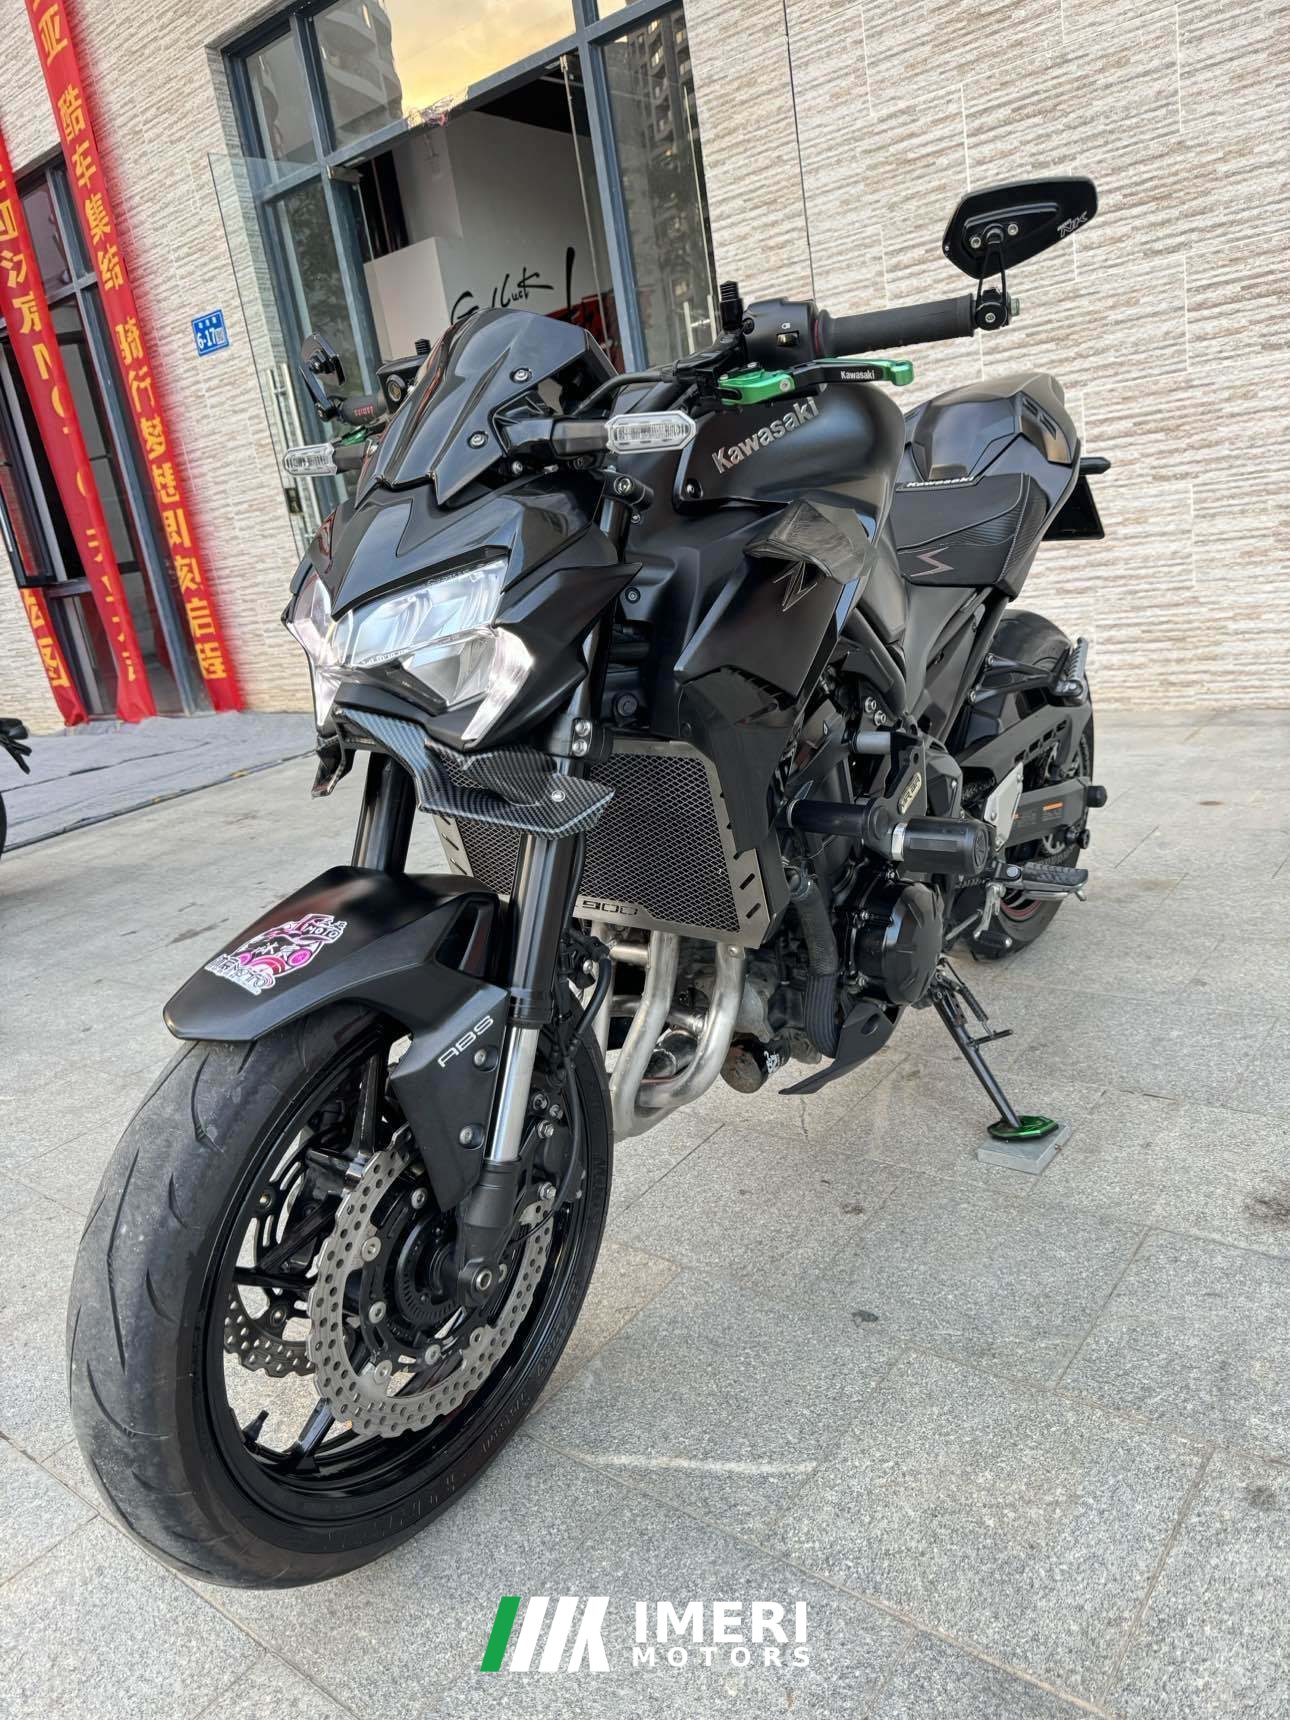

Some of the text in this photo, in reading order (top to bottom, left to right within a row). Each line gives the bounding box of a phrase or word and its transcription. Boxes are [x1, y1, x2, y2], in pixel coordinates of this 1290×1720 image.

[840, 369, 875, 381] Kawasaki
[711, 396, 820, 476] Kawasaki
[437, 1014, 495, 1068] ABS
